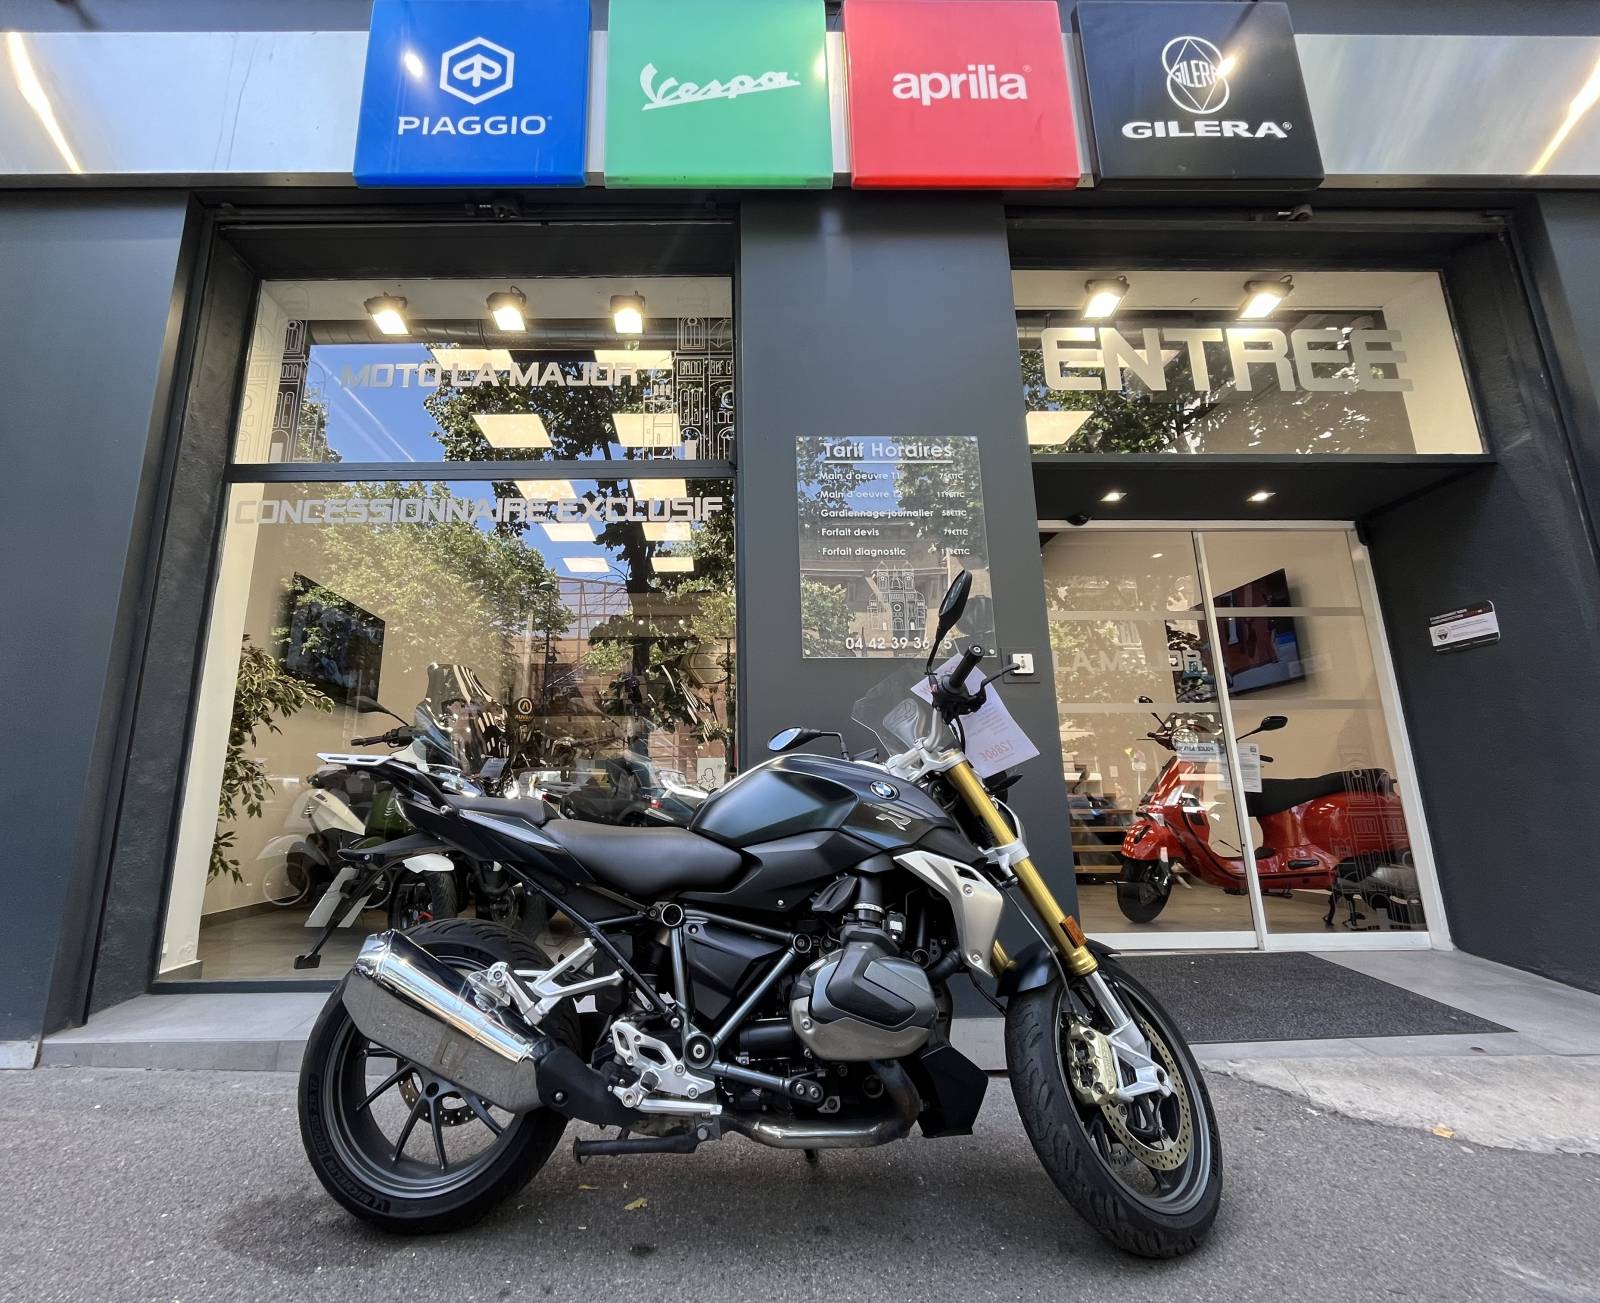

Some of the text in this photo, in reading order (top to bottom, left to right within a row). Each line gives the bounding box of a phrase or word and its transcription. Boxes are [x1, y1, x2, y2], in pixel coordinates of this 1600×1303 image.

[639, 62, 801, 111] Vespa
[892, 64, 1028, 106] aprilia
[397, 115, 547, 136] PIAGGIO
[1121, 120, 1288, 139] GILERA
[1041, 327, 1414, 392] ENTREE
[341, 361, 638, 388] MOTO LA MAJOR
[822, 443, 954, 458] Tarif Horaires
[820, 472, 844, 480] Main
[820, 490, 844, 498] Main
[235, 497, 723, 524] CONCESSIONNAIRE EXCLUSIF
[820, 508, 886, 519] Gardiennage
[887, 508, 934, 519] journalier
[821, 528, 851, 536] Forfait
[854, 528, 880, 536] devis
[822, 547, 853, 556] Forfait
[854, 547, 906, 558] diagnostic
[845, 637, 863, 649] 04
[868, 637, 886, 649] 42
[891, 637, 908, 649] 39
[913, 637, 930, 649] 36
